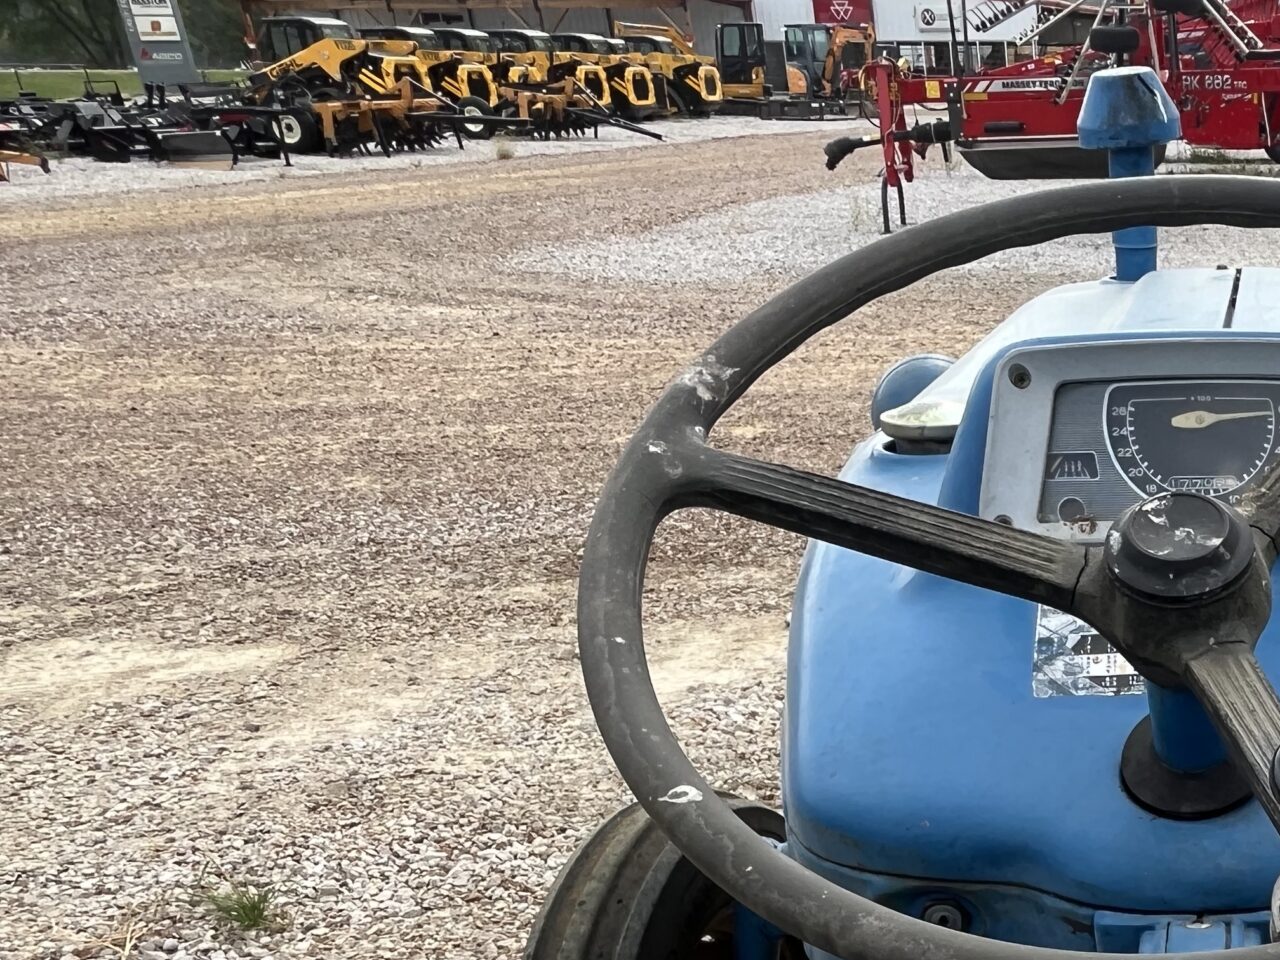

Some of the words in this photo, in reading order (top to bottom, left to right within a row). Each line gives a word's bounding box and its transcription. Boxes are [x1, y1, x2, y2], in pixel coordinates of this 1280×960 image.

[1112, 427, 1127, 436] 24
[1117, 448, 1133, 458] 22
[1128, 468, 1144, 477] 20
[1146, 484, 1157, 494] 18
